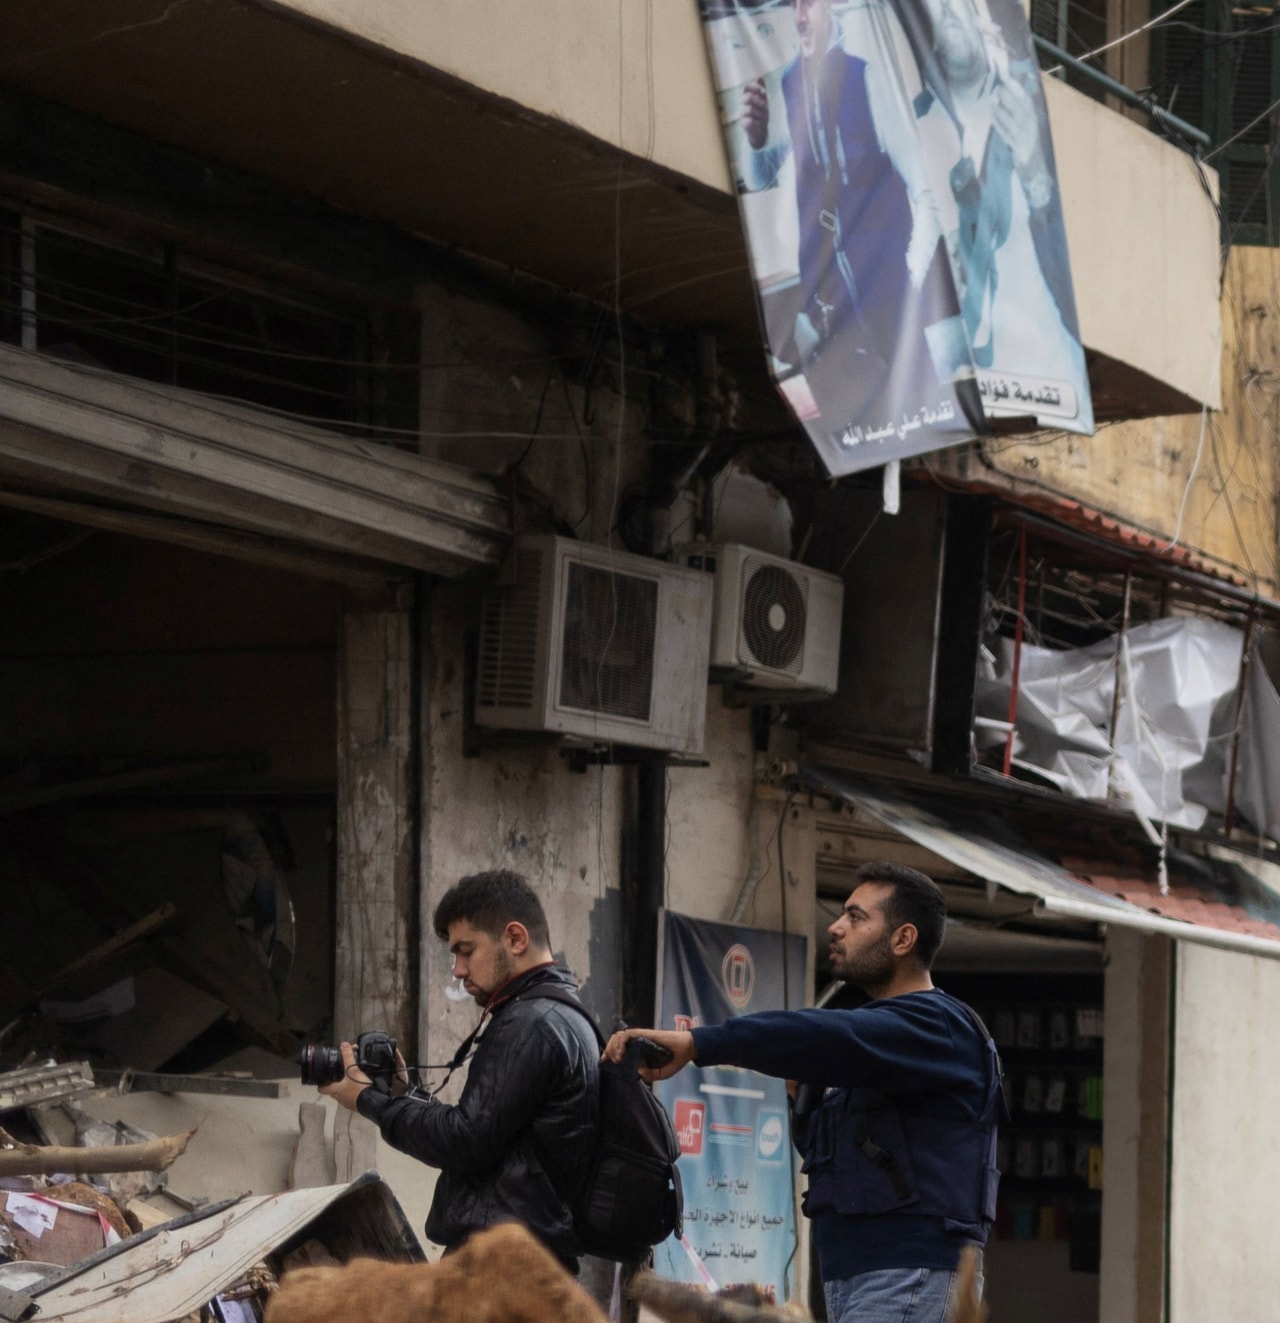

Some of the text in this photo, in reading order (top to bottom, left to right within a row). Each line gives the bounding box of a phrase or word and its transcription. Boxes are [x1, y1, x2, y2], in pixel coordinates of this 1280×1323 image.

[1012, 381, 1060, 405] تقدمة
[842, 400, 955, 445] تقدمة علي عبد الله
[735, 1179, 748, 1195] بيع
[761, 1214, 784, 1230] جميع
[730, 1242, 757, 1263] صيانة
